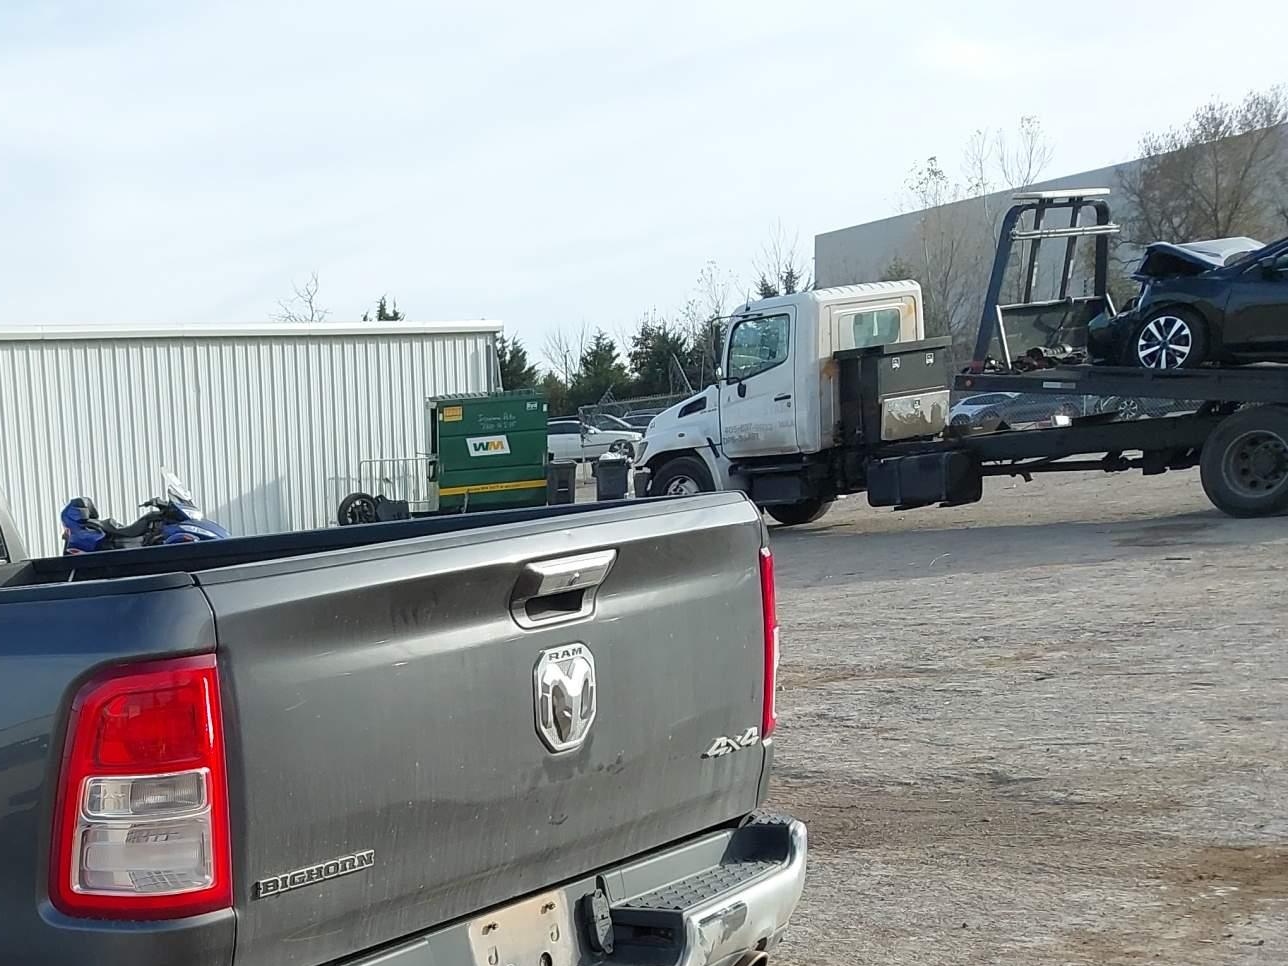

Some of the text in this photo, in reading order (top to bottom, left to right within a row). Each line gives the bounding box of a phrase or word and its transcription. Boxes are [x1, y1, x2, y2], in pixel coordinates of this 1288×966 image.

[472, 440, 505, 452] WM
[548, 647, 583, 661] RAM
[257, 849, 375, 898] BIGHORN
